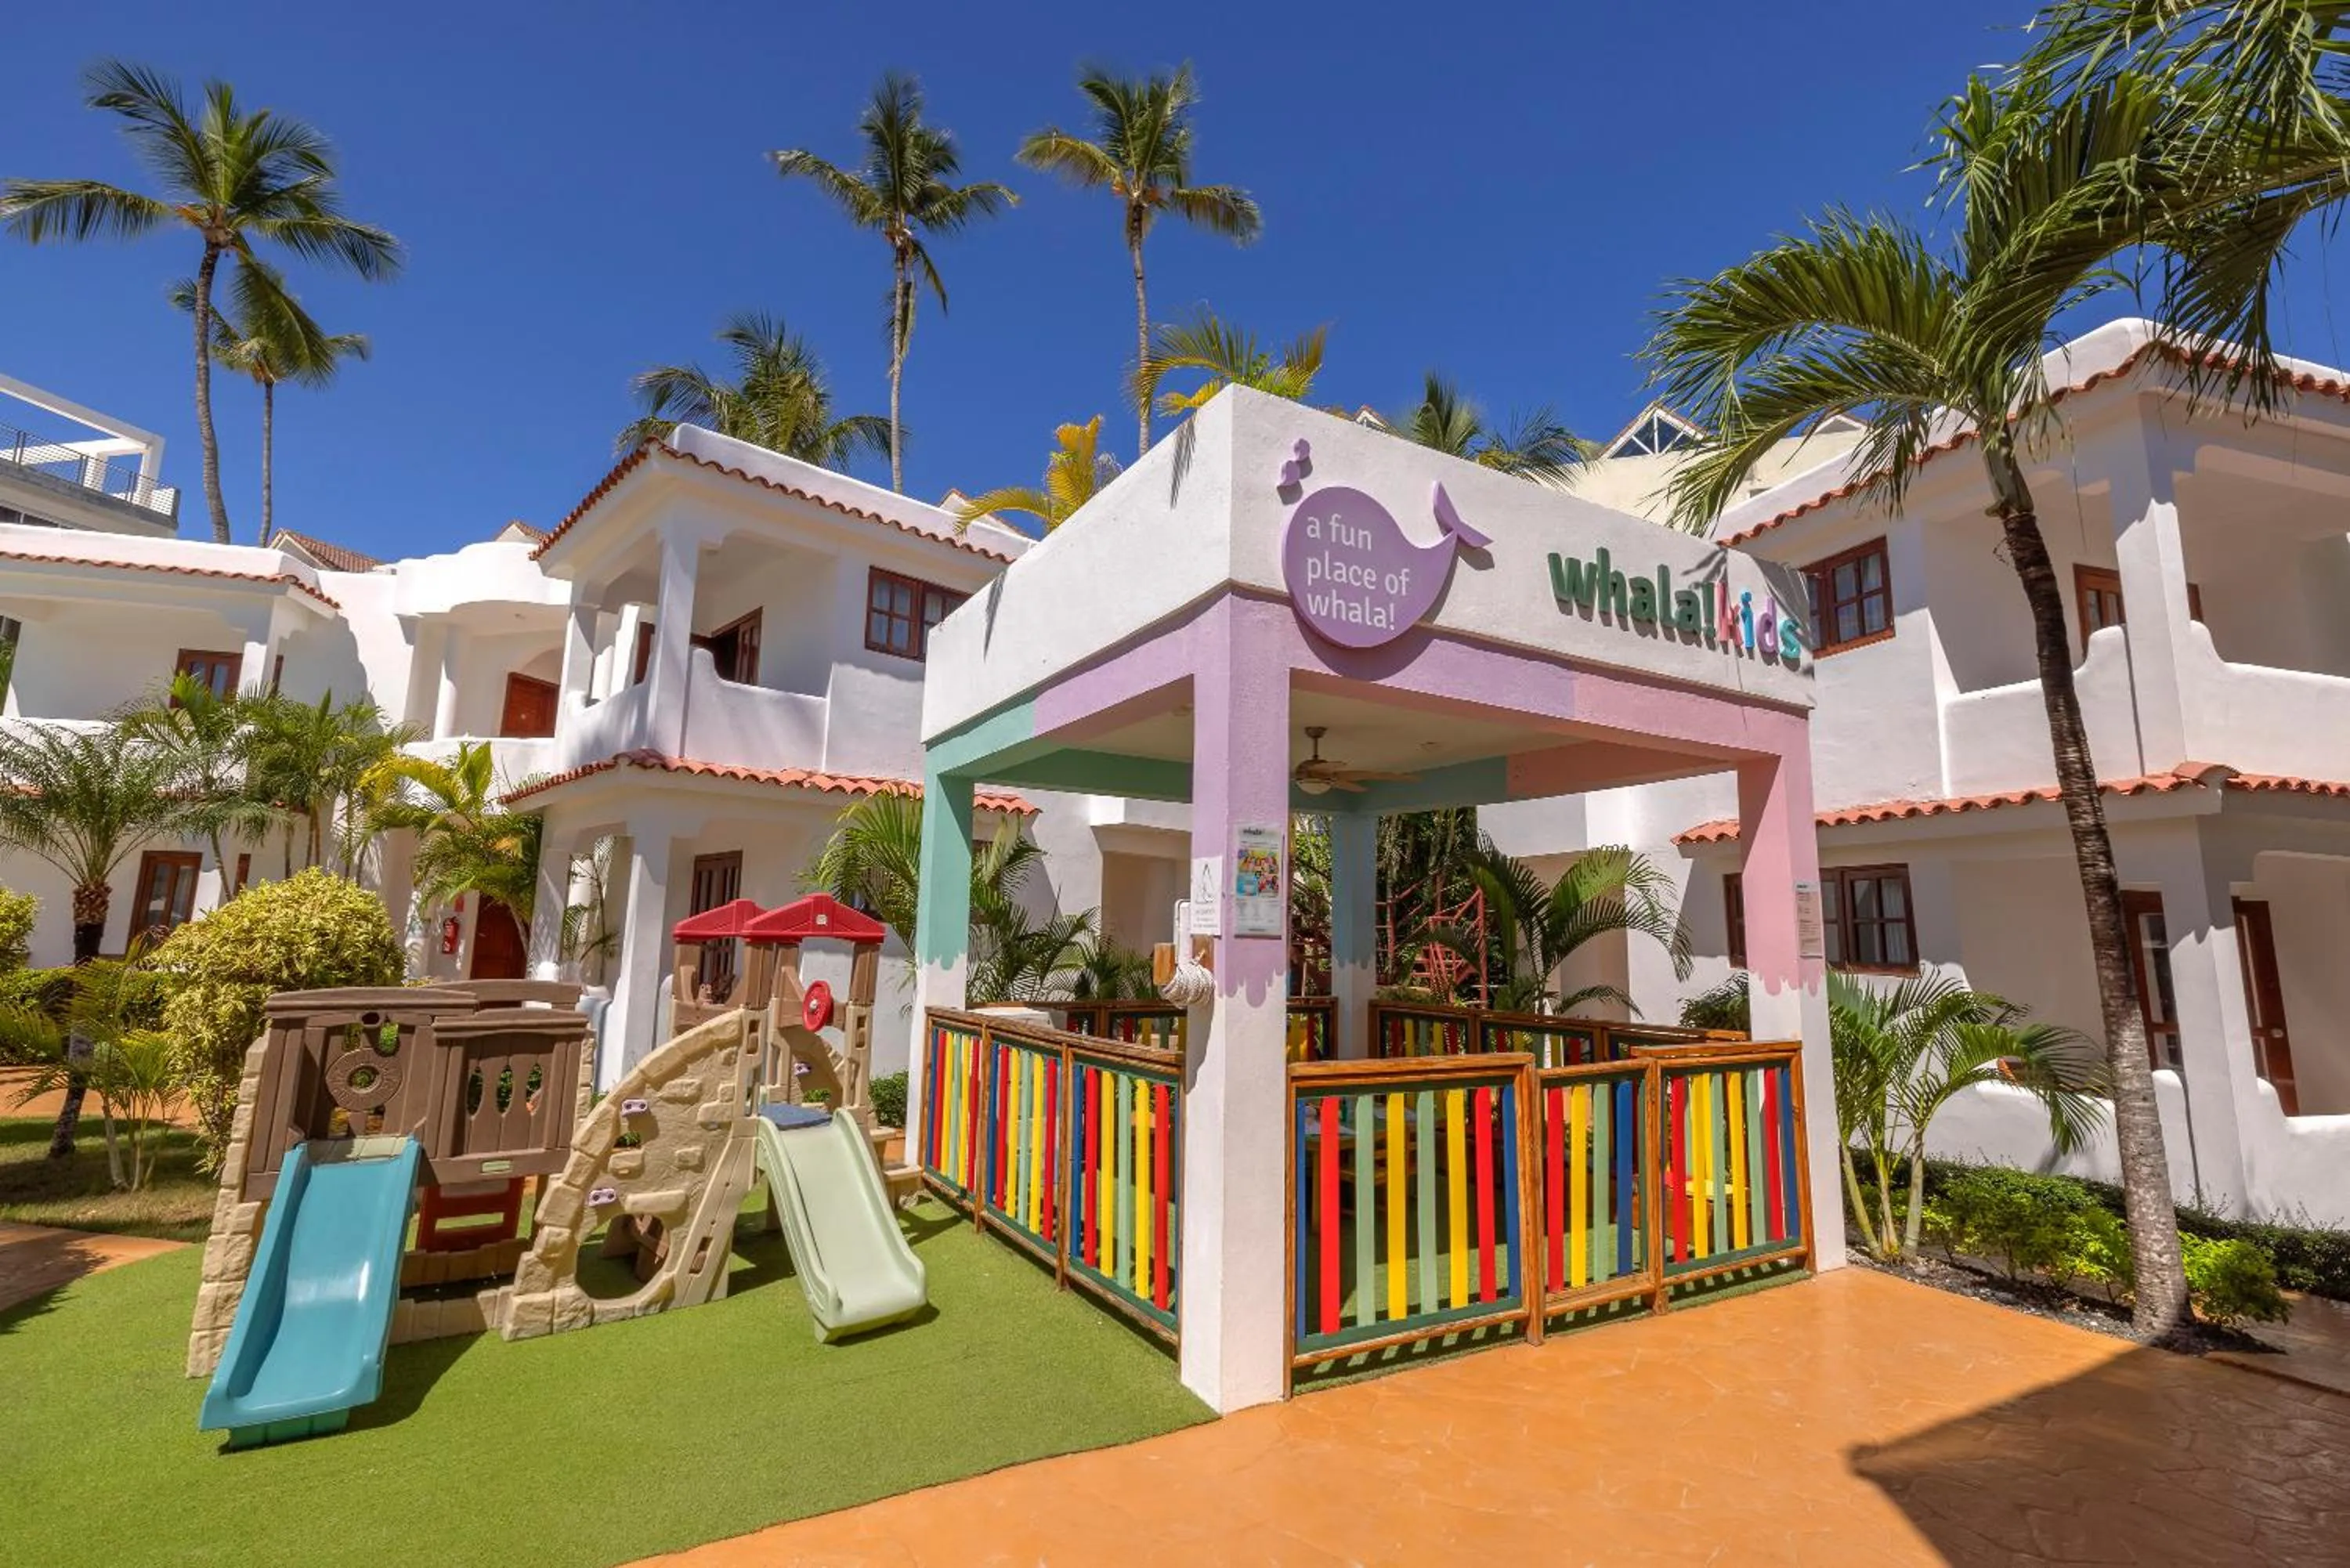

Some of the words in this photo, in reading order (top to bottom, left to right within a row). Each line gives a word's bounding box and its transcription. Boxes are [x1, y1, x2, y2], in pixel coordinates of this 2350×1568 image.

[1306, 515, 1321, 539] a
[1329, 513, 1372, 551] fun
[1307, 551, 1377, 589] place
[1384, 568, 1410, 596] of
[1307, 589, 1396, 630] whala!
